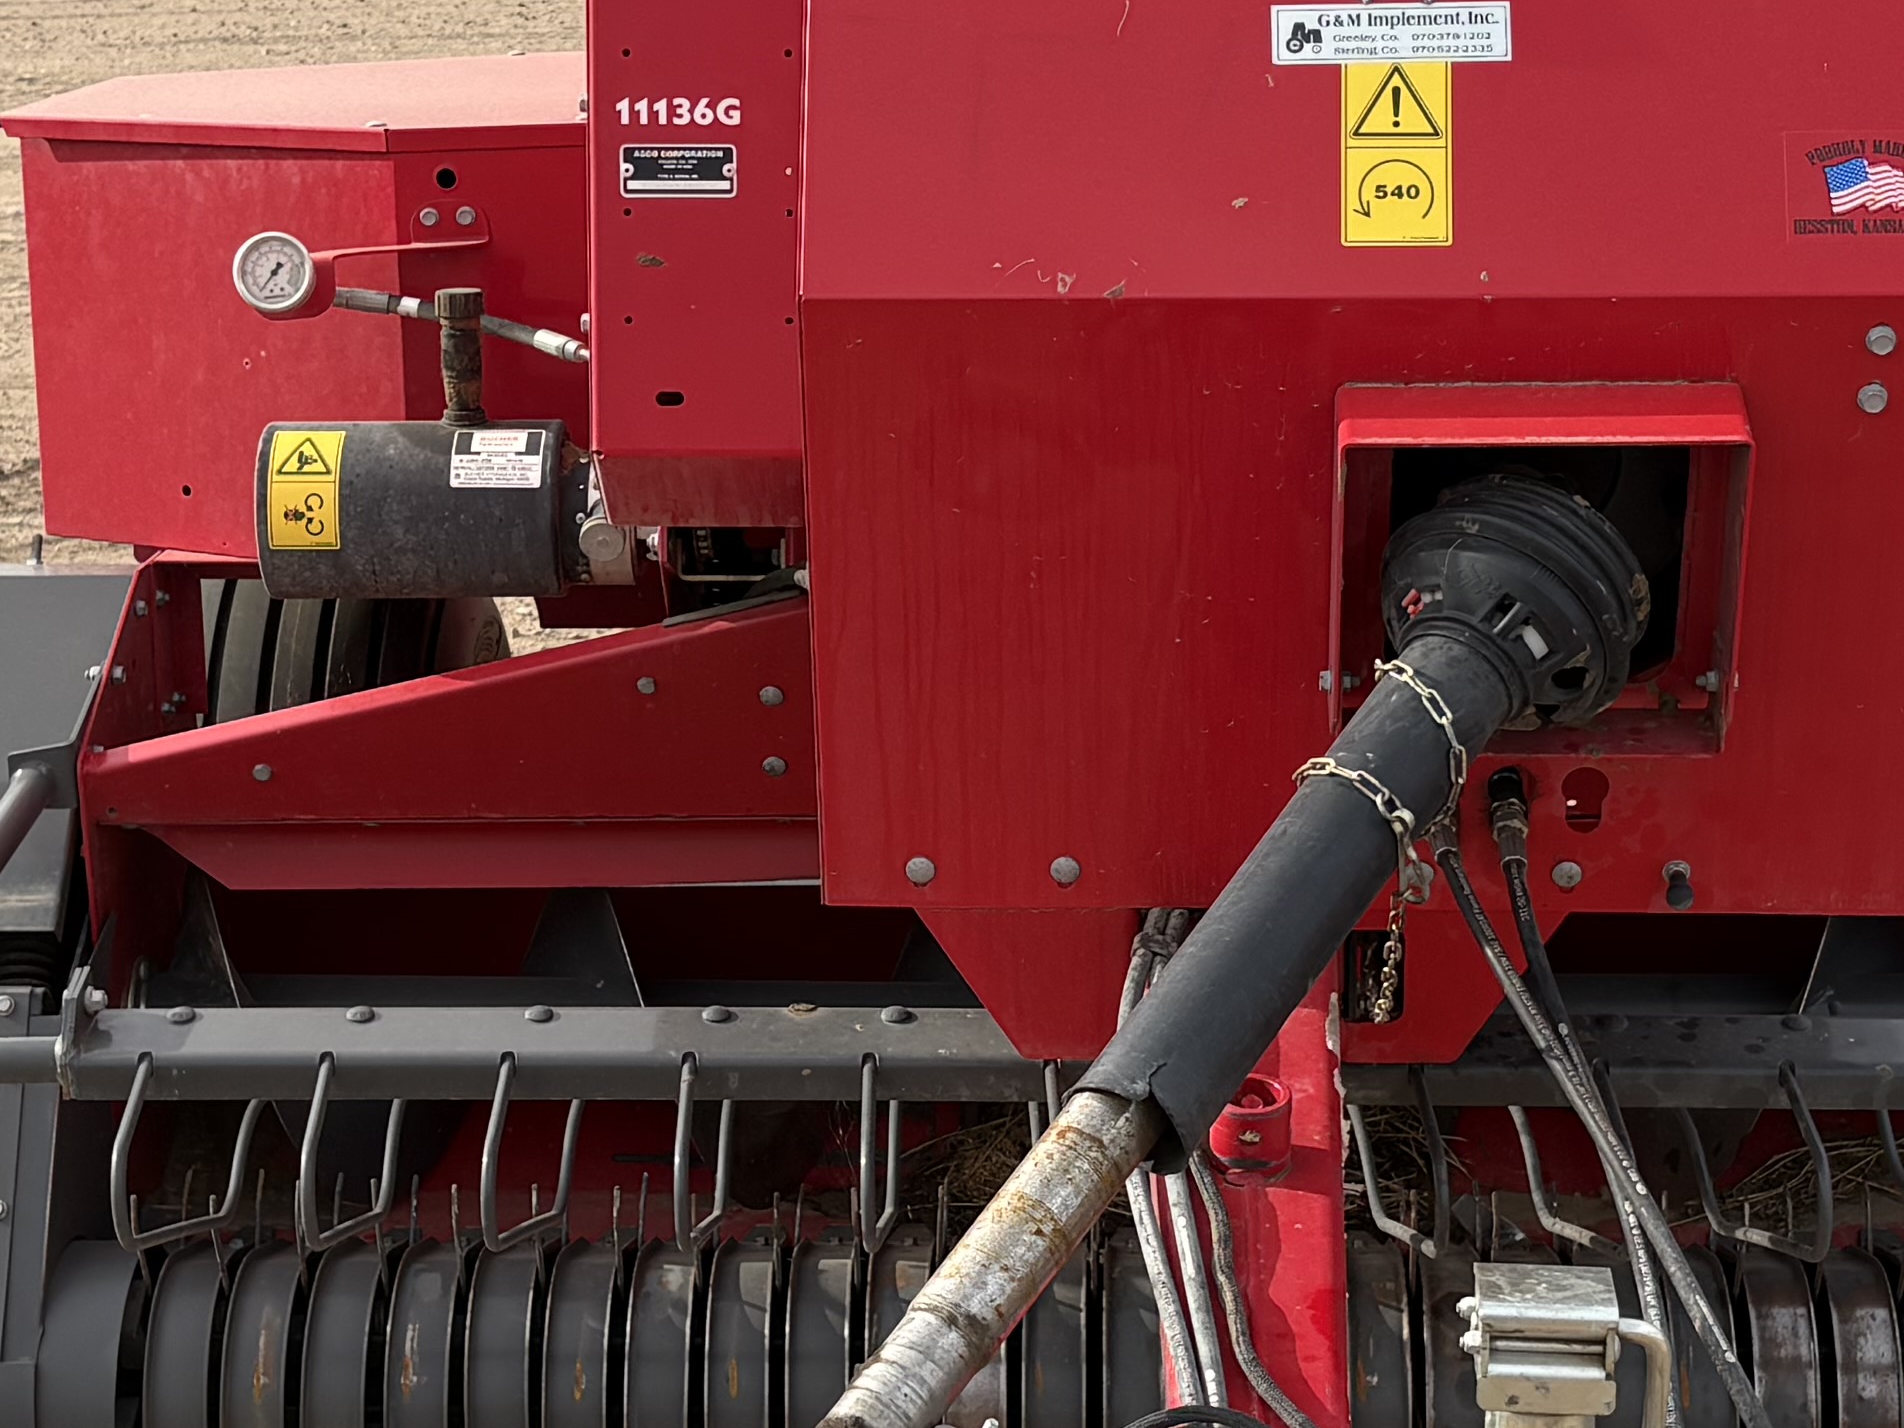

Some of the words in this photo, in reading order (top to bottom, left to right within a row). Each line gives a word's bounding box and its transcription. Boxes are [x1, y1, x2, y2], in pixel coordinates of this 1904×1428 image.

[1367, 11, 1465, 30] Implement,
[1468, 10, 1500, 26] Inc.
[615, 97, 741, 125] 11136G
[660, 150, 723, 158] CORPORATION
[1804, 139, 1868, 166] PROUDLY
[1374, 184, 1420, 200] 540
[1794, 218, 1857, 235] HESSTON,
